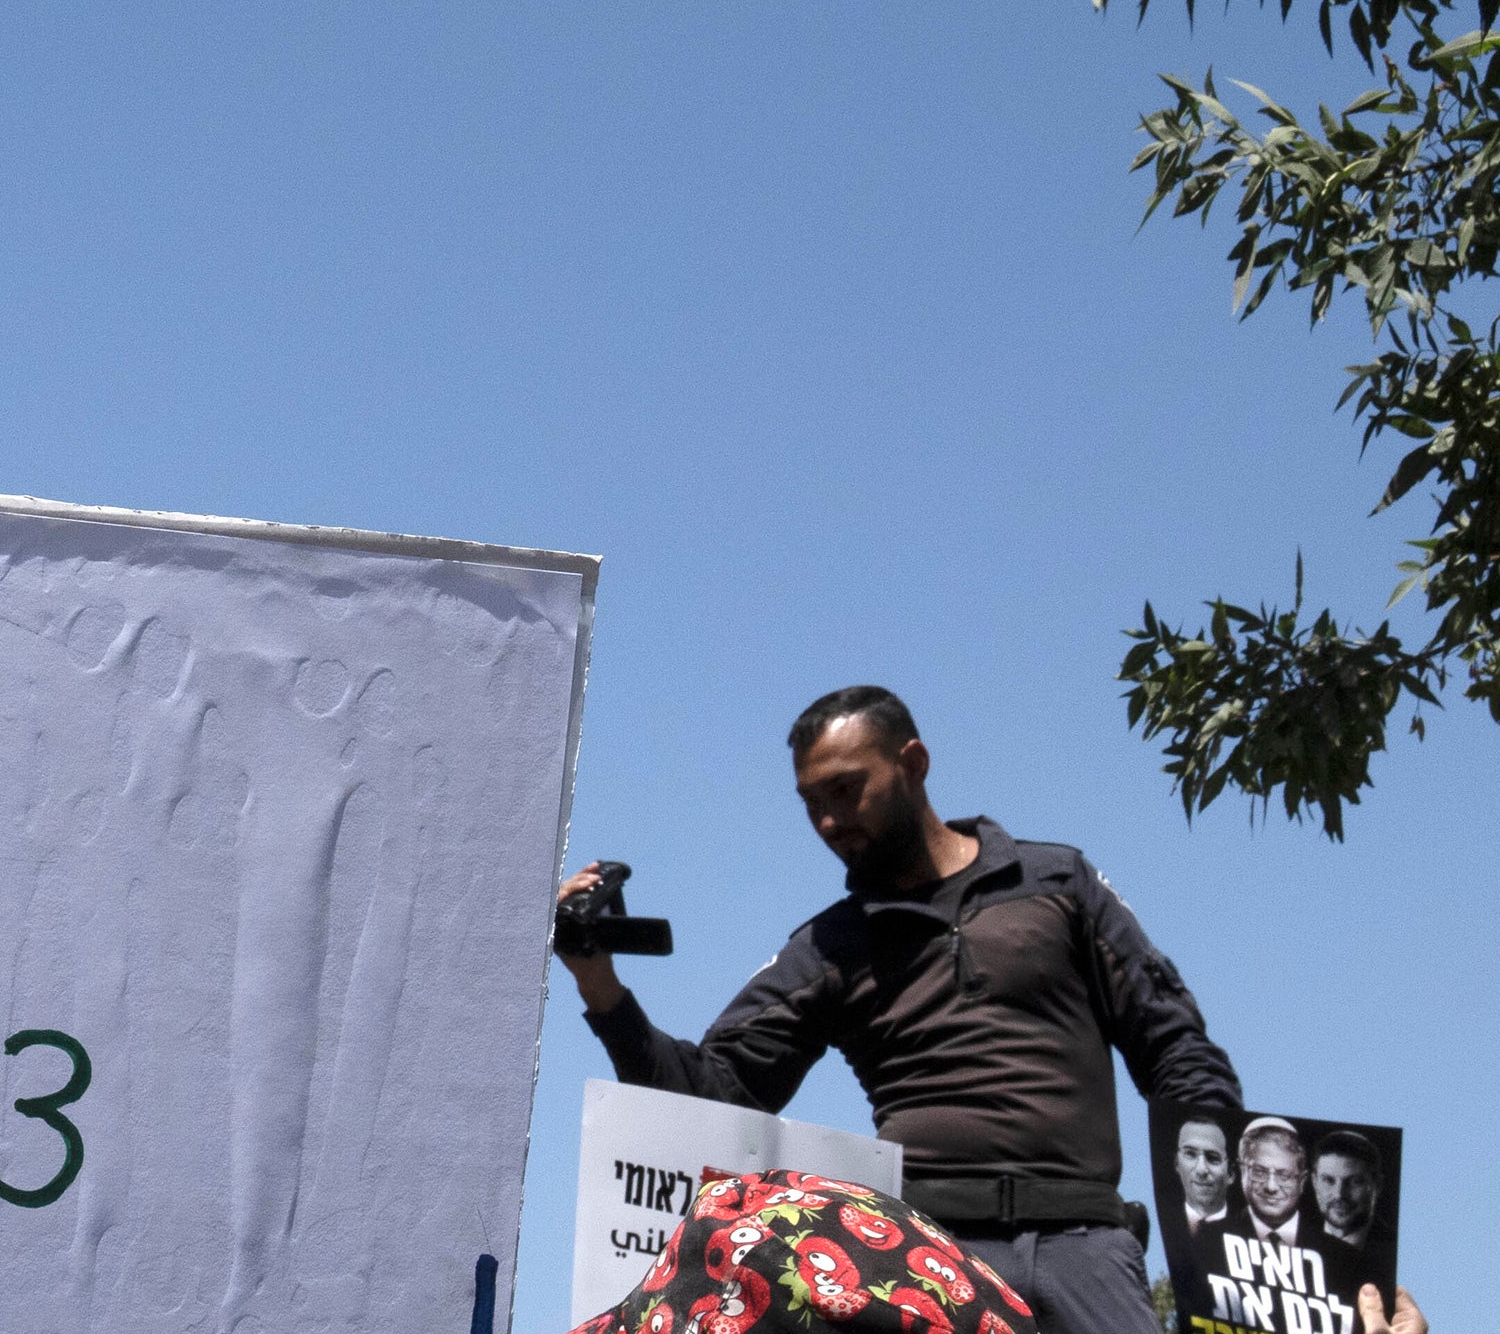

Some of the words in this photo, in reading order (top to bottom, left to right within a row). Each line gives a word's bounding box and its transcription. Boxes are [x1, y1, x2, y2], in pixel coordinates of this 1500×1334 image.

[614, 1159, 694, 1217] לאומי
[1222, 1232, 1326, 1298] רואים
[1208, 1273, 1276, 1333] את
